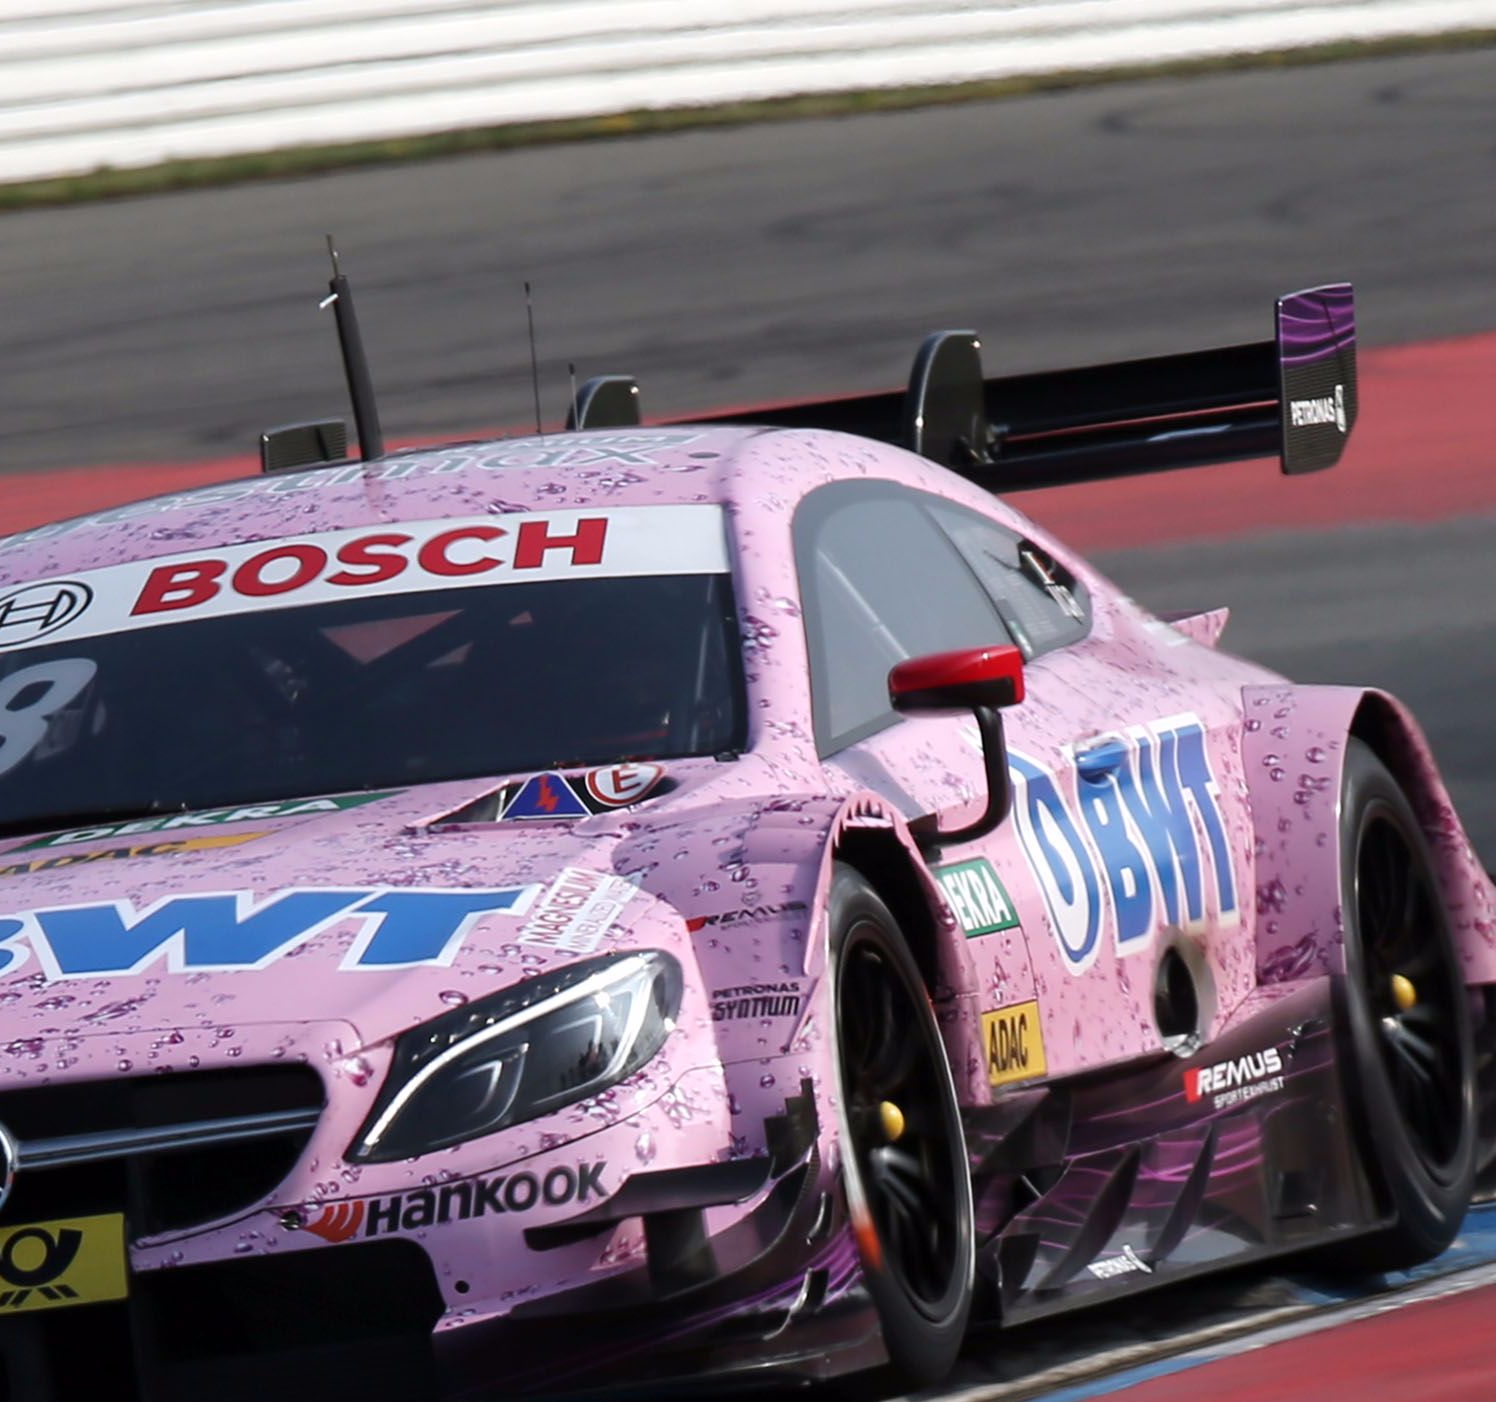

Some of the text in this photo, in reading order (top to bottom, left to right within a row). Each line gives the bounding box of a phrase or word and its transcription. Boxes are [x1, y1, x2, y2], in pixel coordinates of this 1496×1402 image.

[131, 517, 608, 617] BOSCH
[49, 799, 339, 846] DEKRA
[1074, 720, 1237, 945] BWT
[712, 982, 800, 999] PETRONAS
[988, 1012, 1029, 1075] ADAC
[1196, 1047, 1283, 1097] REMUS
